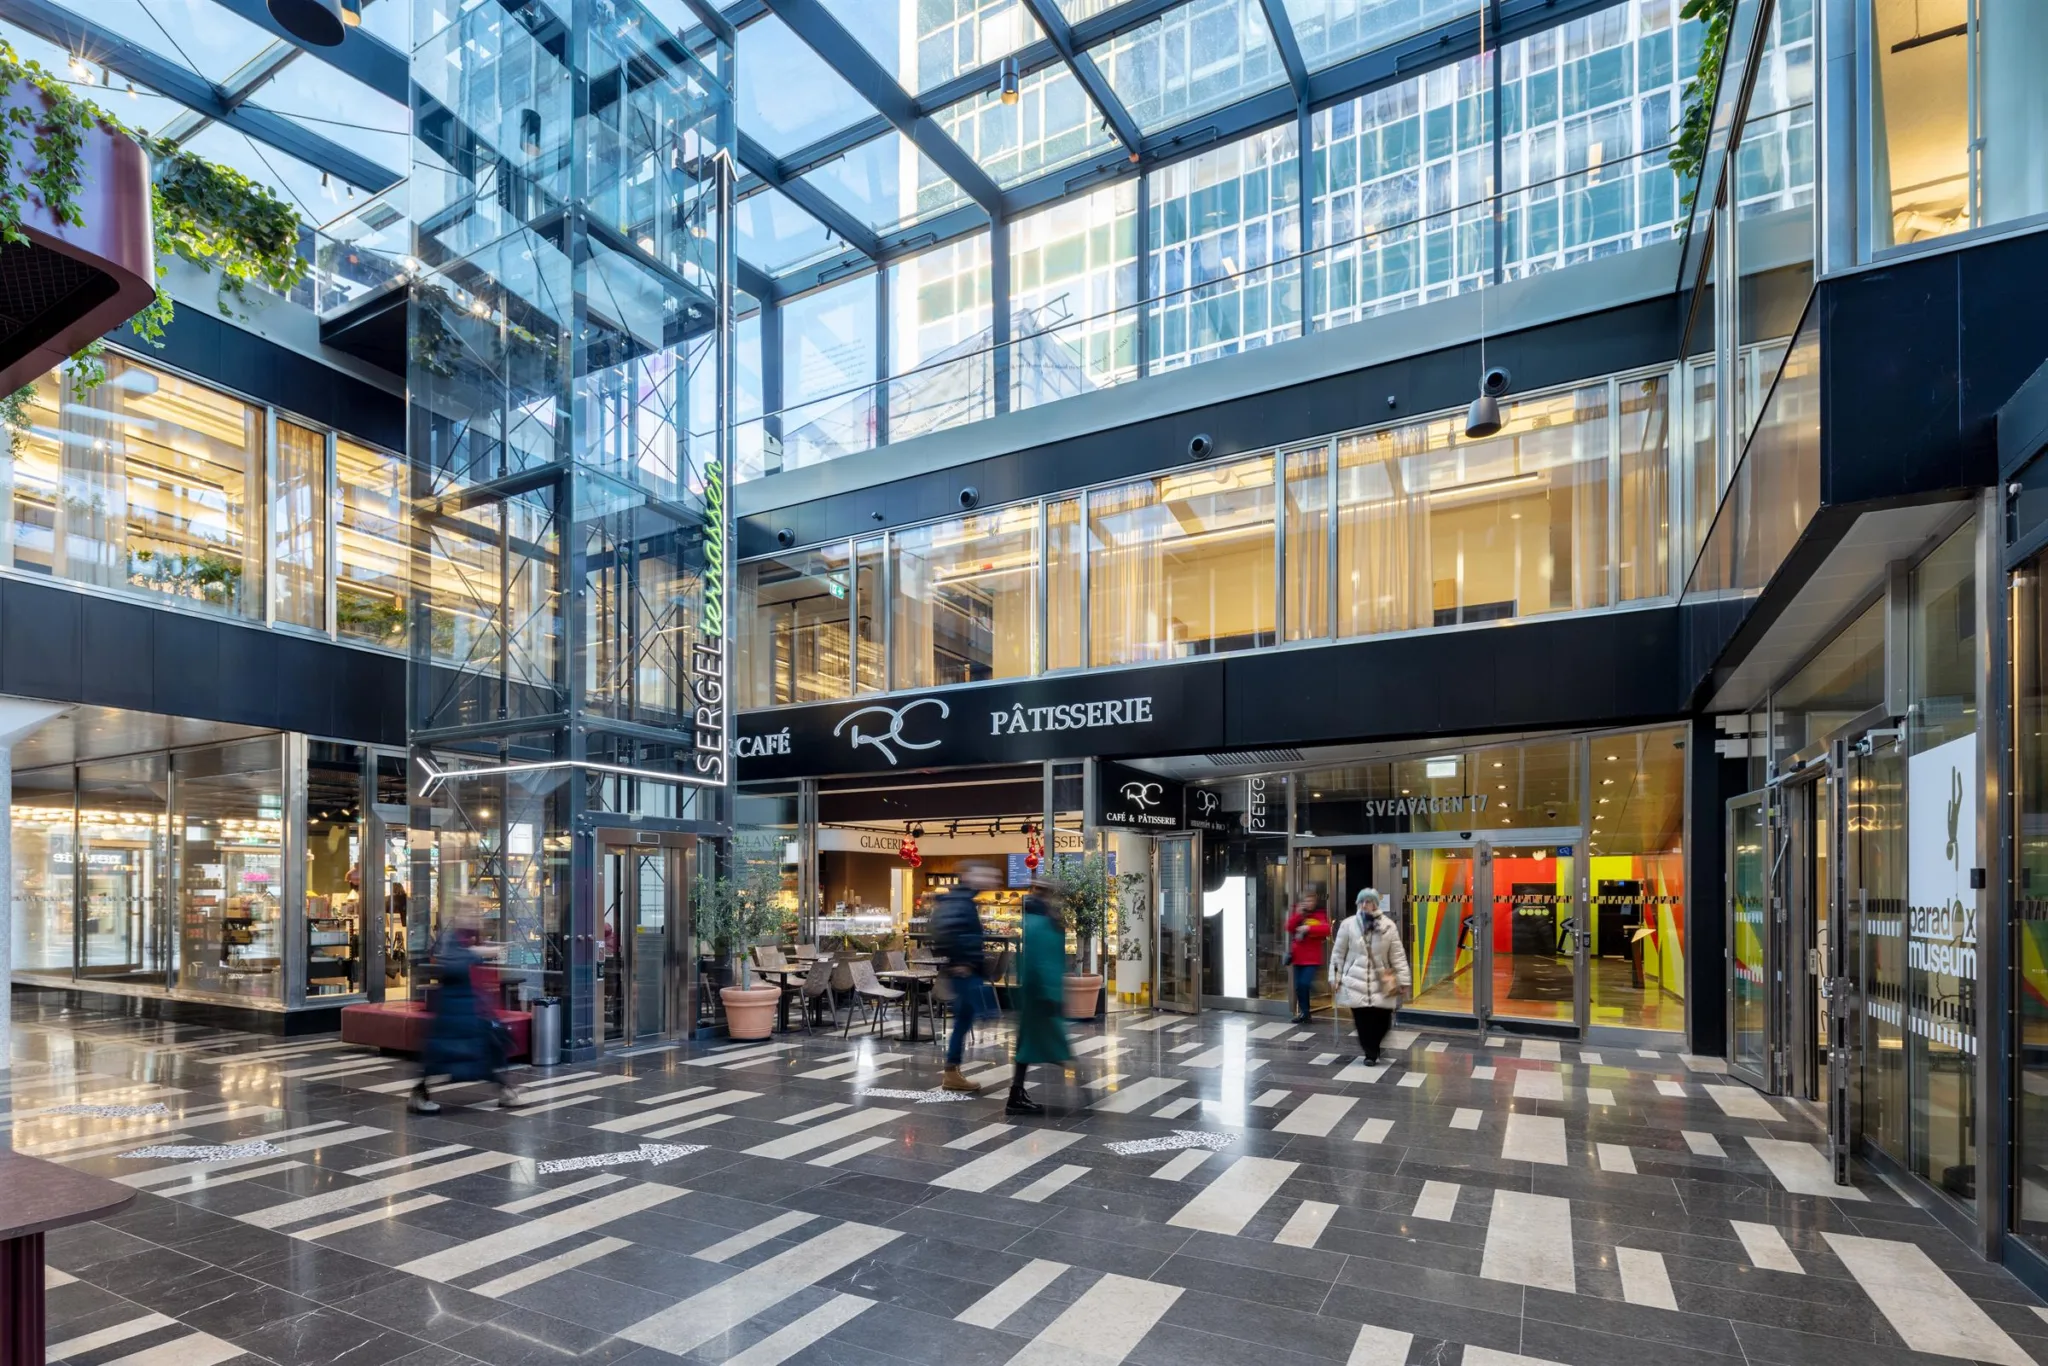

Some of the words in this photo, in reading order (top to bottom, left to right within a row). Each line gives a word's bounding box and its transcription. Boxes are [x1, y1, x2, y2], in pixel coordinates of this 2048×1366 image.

[699, 459, 723, 638] terrassen
[696, 636, 723, 775] SERGEL
[990, 696, 1153, 736] PÂTISSERIE
[736, 727, 791, 758] CAFÉ
[1106, 811, 1127, 822] CAFÉ
[1128, 814, 1135, 823] &
[1138, 813, 1176, 825] PÂTISSERIE
[1365, 794, 1465, 817] SVEAVÄGEN
[1470, 794, 1488, 813] 17
[1203, 875, 1248, 998] 1
[1908, 939, 1977, 981] museum
